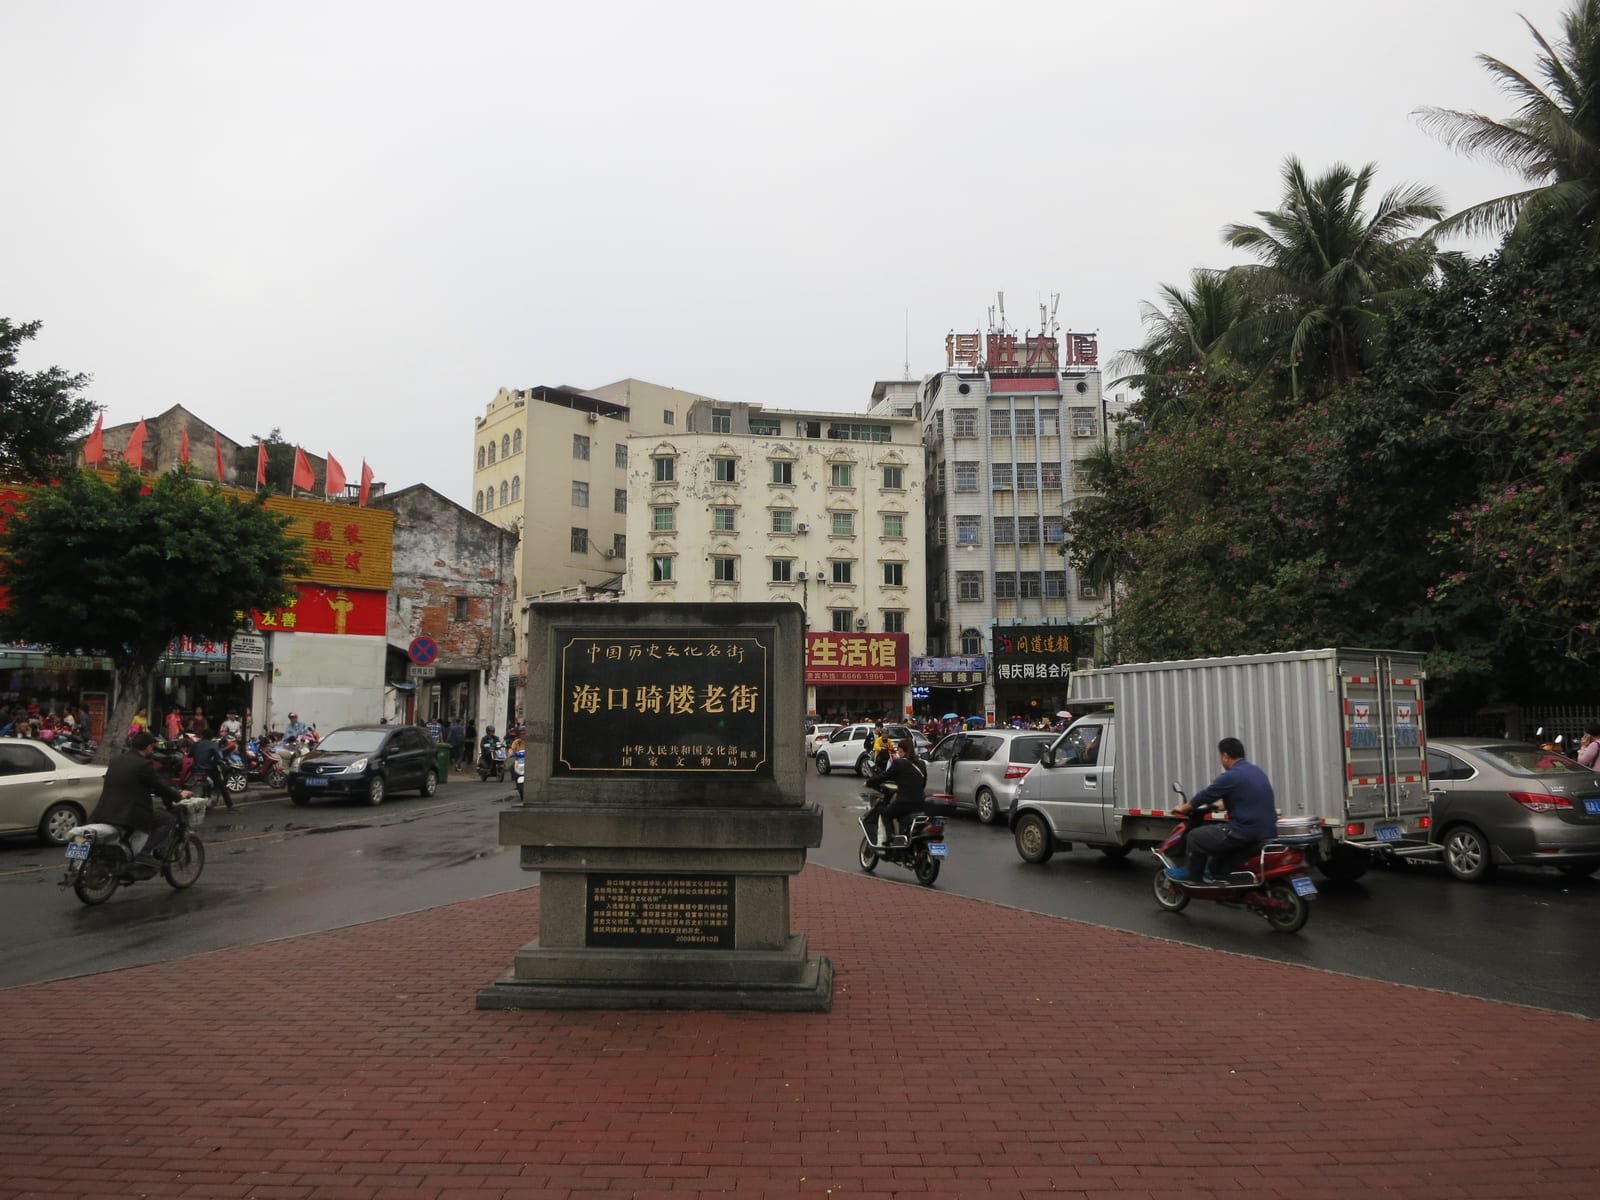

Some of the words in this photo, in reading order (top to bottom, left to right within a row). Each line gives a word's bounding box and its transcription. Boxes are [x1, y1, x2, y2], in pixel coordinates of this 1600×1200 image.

[261, 611, 297, 628] 友善
[587, 643, 745, 664] 中国历史文化名街
[805, 637, 897, 667] 生活馆
[998, 663, 1071, 679] 得庆网络会所
[572, 684, 759, 714] 海口骑楼老街
[622, 744, 738, 756] 中华人民共和国文化部
[622, 756, 738, 767] 国家文物局
